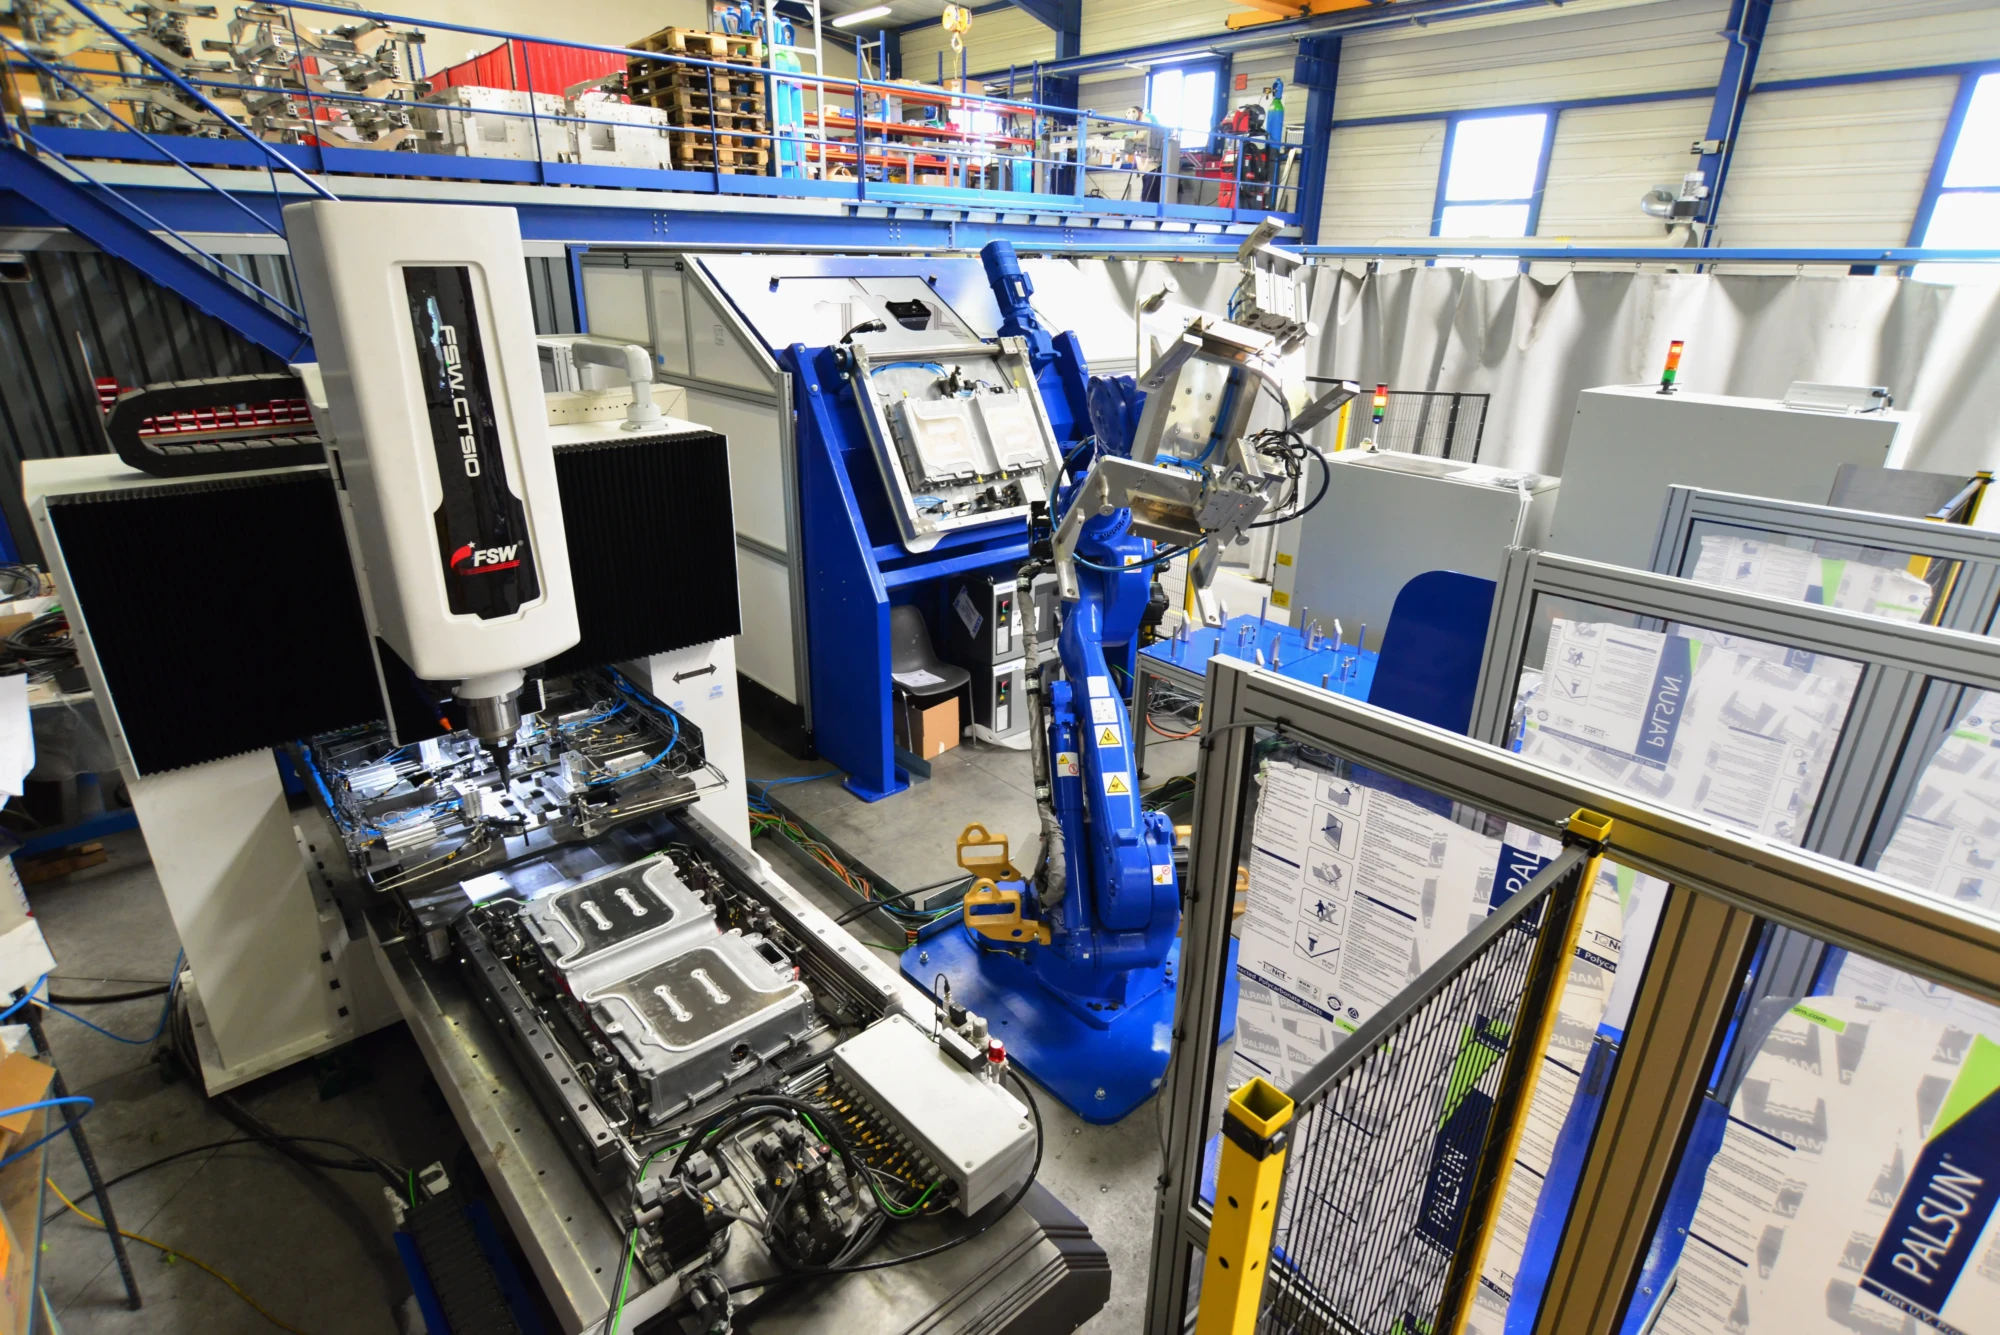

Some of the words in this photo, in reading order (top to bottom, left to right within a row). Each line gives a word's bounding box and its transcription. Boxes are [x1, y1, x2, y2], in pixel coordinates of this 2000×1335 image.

[439, 325, 466, 391] FSW
[474, 545, 518, 567] FSW
[1258, 976, 1300, 1004] Polycarbonate
[1301, 1000, 1323, 1016] Sheets
[1243, 1037, 1281, 1055] PALRAM
[1428, 1143, 1468, 1232] PALSUN
[1892, 1160, 1984, 1286] PALSUN
[1880, 1289, 1907, 1309] Flat
